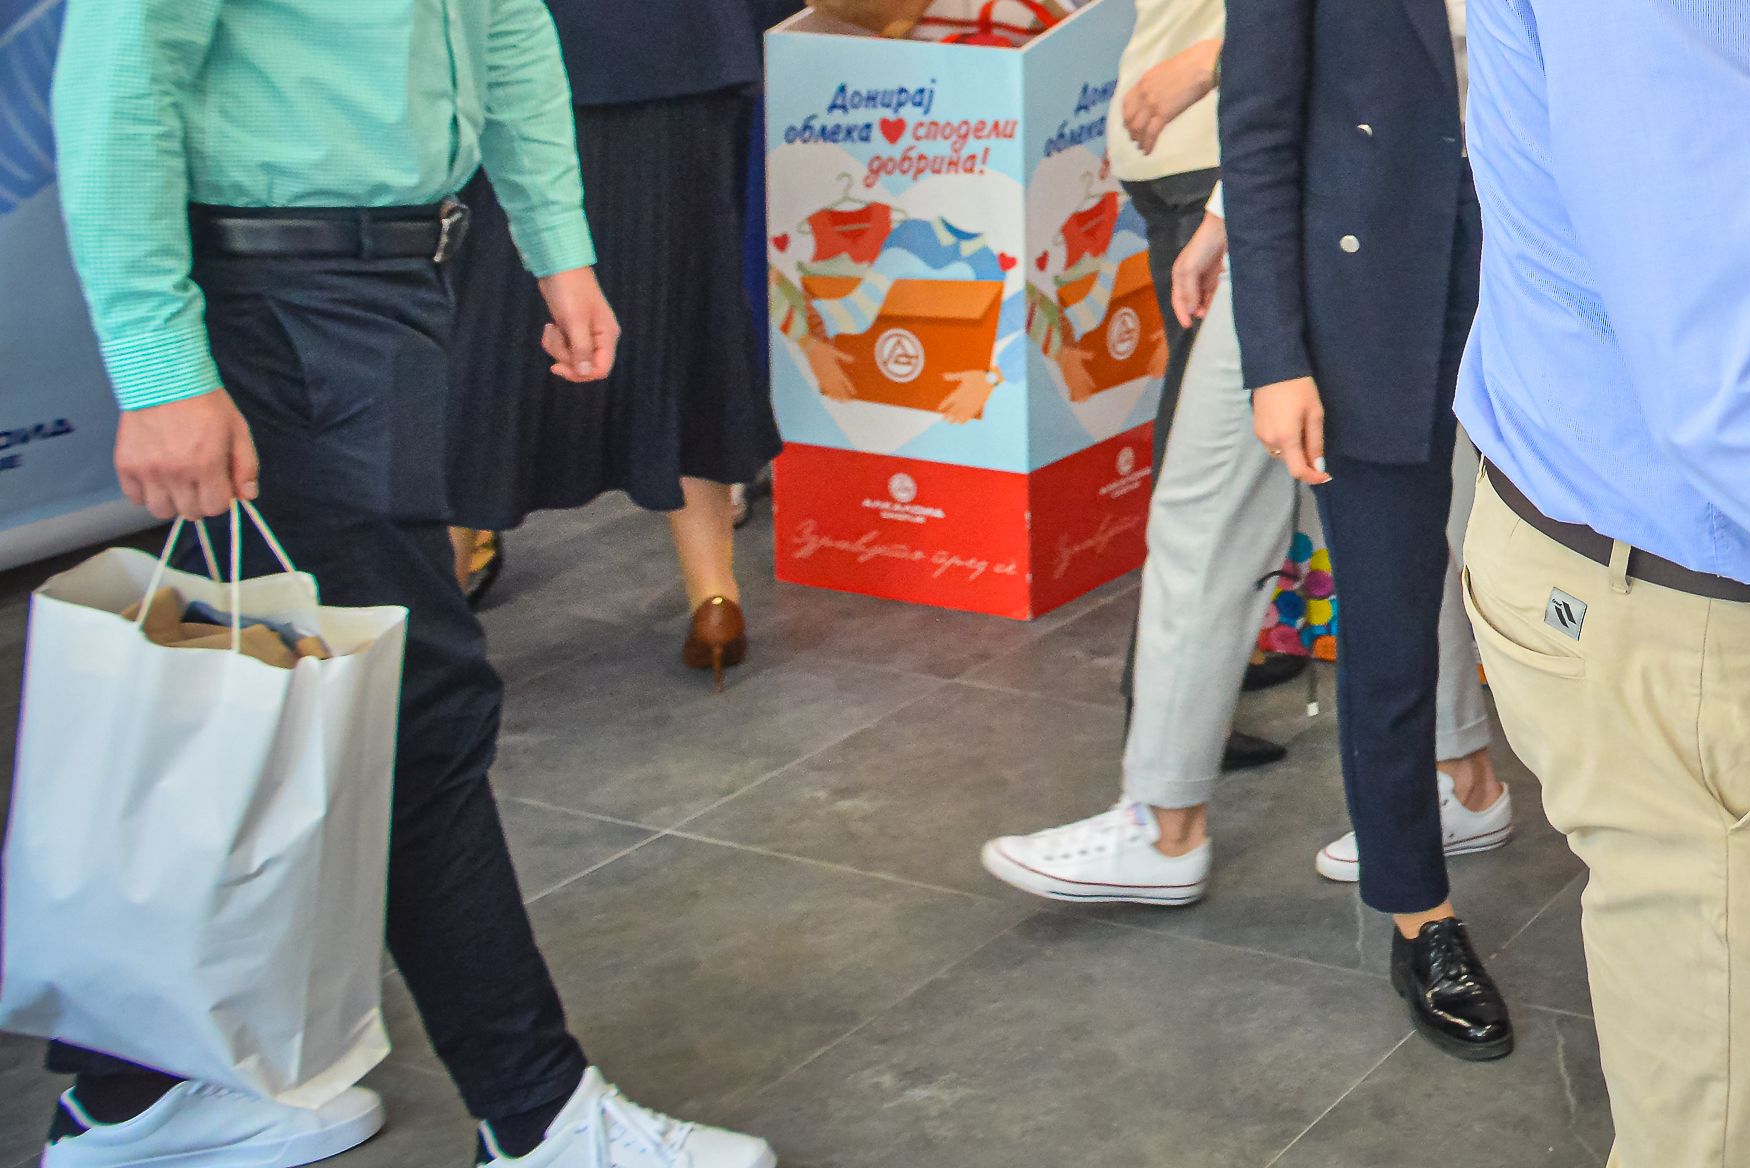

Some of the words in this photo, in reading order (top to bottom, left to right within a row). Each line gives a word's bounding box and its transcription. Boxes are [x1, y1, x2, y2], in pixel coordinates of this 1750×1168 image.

[827, 78, 937, 115] Донирај
[784, 114, 873, 144] облека
[912, 119, 1017, 154] сподели
[862, 146, 990, 188] добрина!
